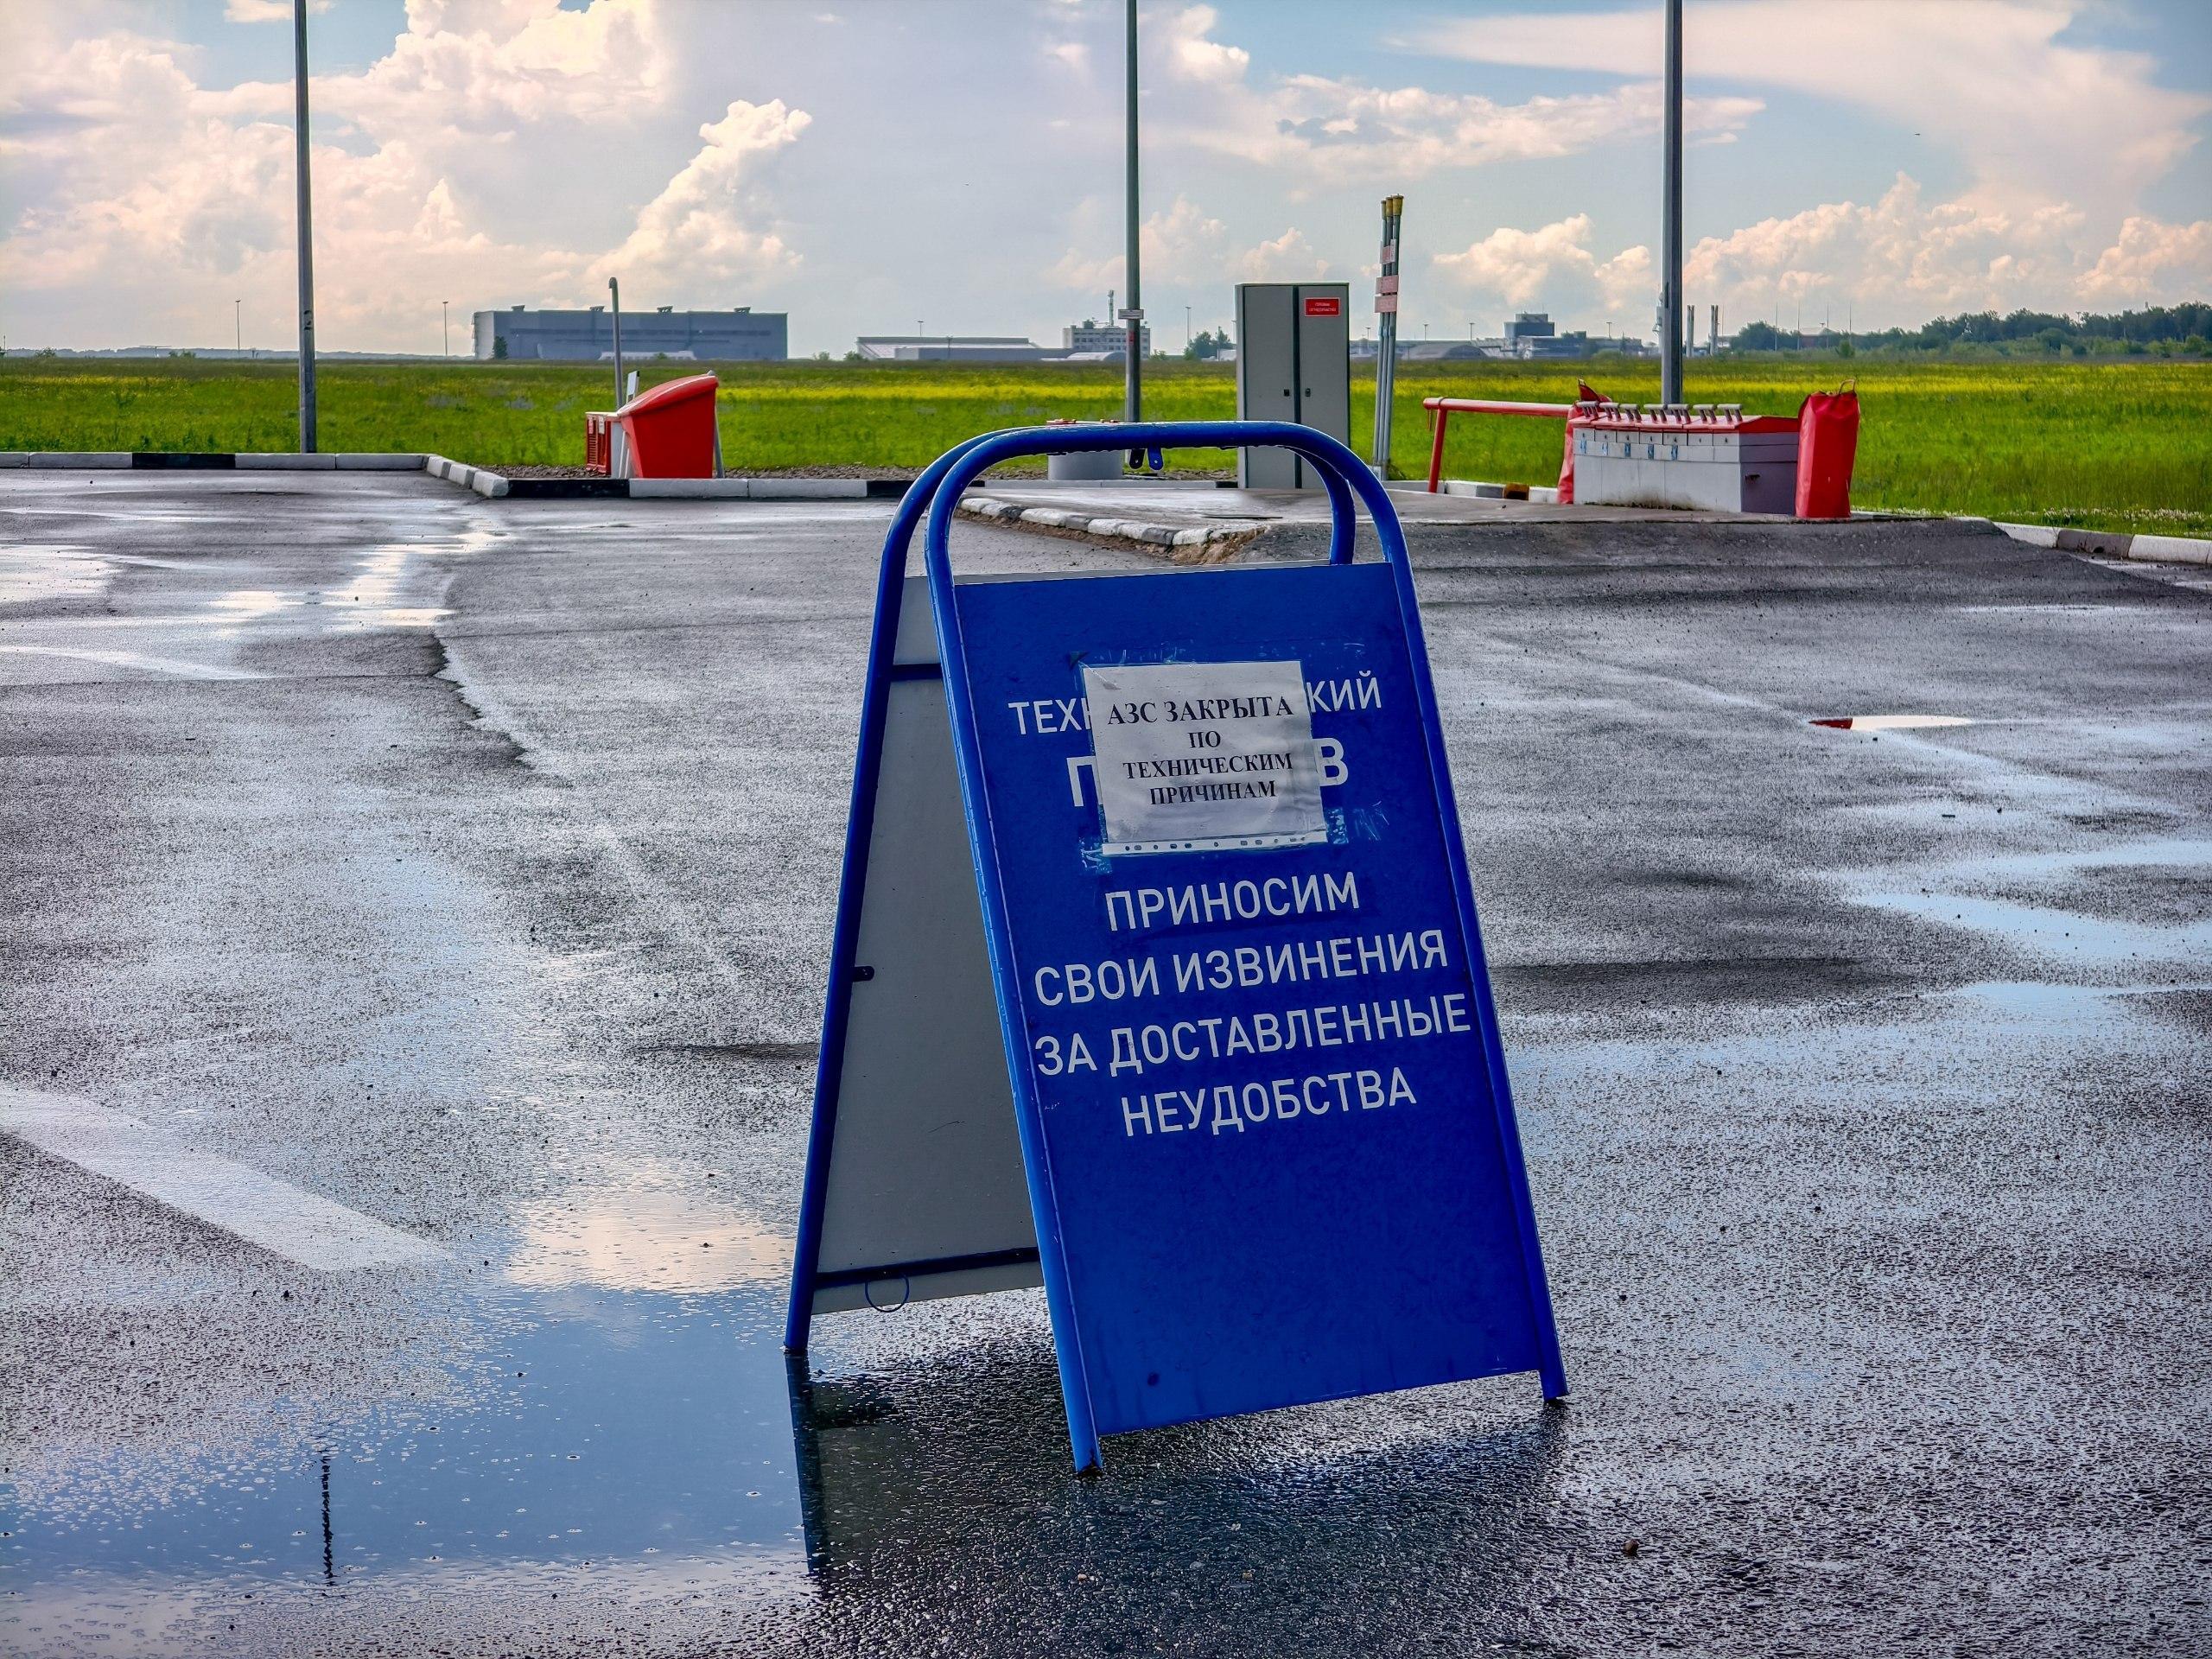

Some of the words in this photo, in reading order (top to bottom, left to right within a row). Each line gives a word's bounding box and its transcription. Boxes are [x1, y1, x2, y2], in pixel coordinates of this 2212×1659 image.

[1108, 702, 1157, 724] АЗС
[1164, 696, 1294, 721] ЗАКРЫТА
[1187, 731, 1221, 748] ПО
[1122, 752, 1294, 779] ТЕХНИЧЕСКИМ
[1150, 780, 1275, 804] ПРИЧИНАМ
[1105, 872, 1359, 931] ПРИНОСИМ
[1035, 957, 1159, 1005] СВОИ
[1173, 930, 1447, 992] ИЗВИНЕНИЯ
[1036, 1033, 1097, 1075] ЗА
[1109, 994, 1470, 1077] ДОСТАВЛЕННЫЕ
[1122, 1067, 1416, 1136] НЕУДОБСТВА
